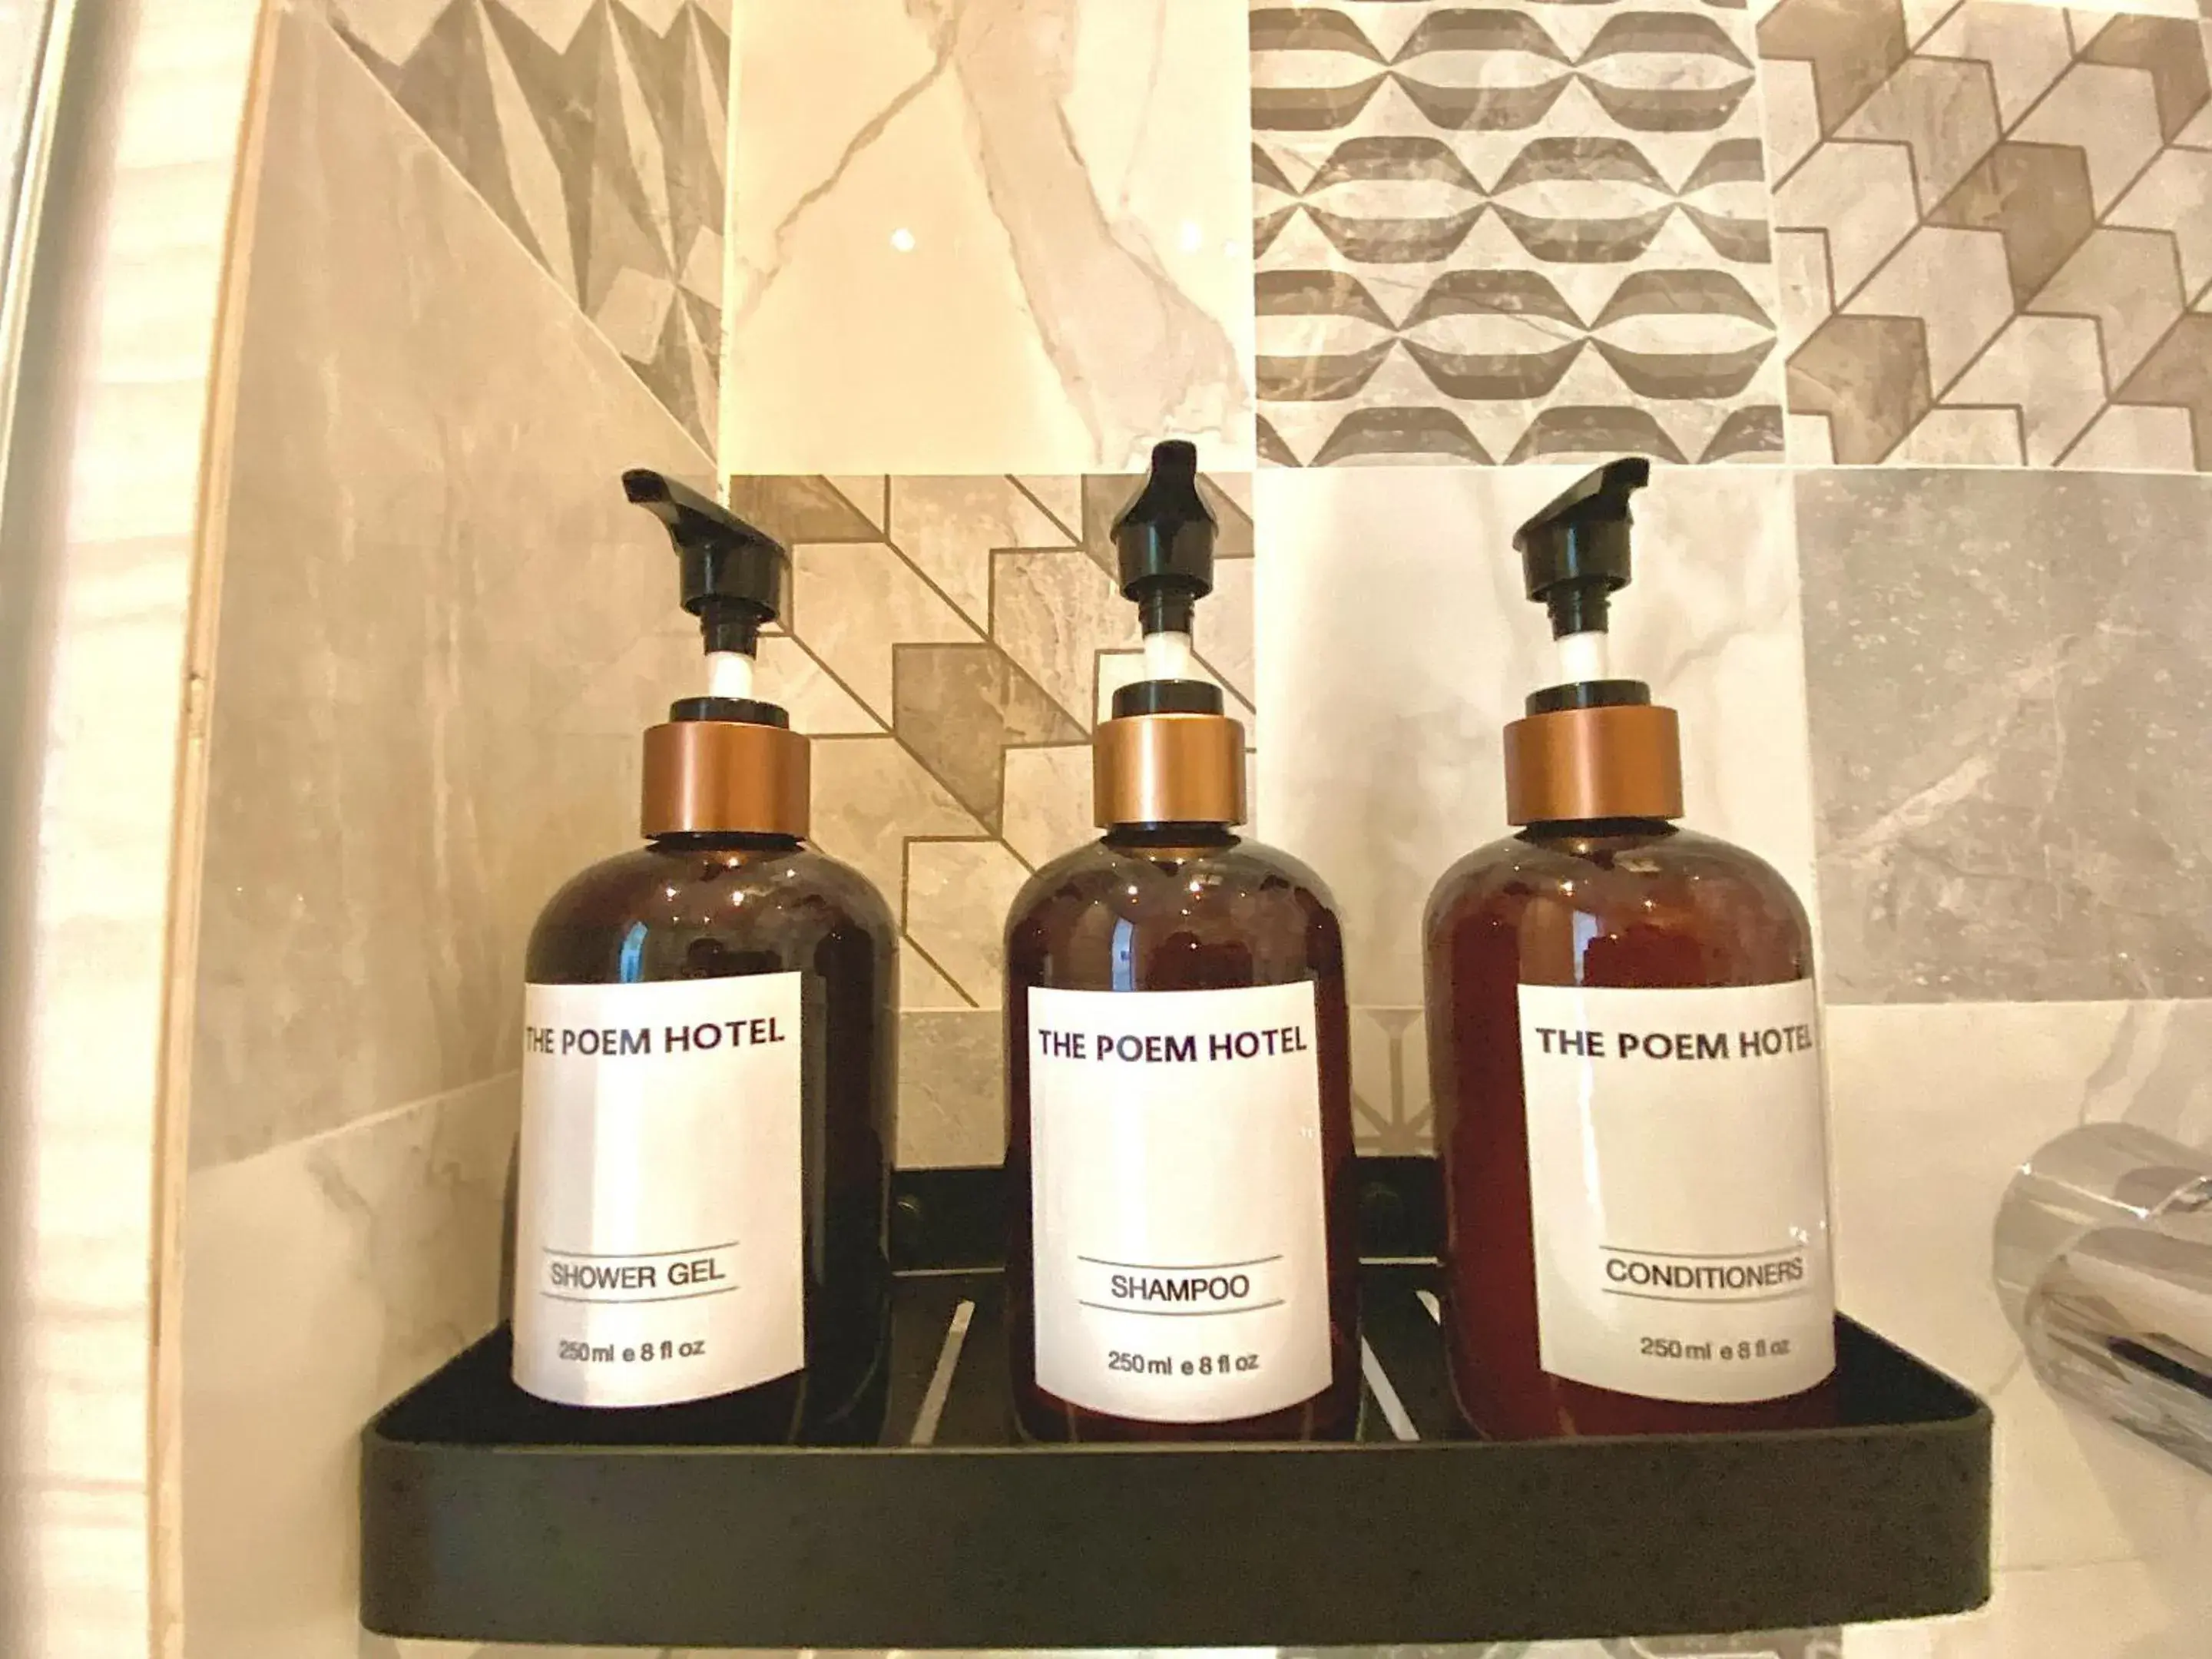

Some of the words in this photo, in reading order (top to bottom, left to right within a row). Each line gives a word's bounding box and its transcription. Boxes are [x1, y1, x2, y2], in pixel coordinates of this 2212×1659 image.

[527, 1026, 554, 1054] THE
[562, 1028, 651, 1055] POEM
[665, 1017, 785, 1053] HOTEL
[1038, 1029, 1086, 1060] THE
[1097, 1035, 1196, 1062] POEM
[1209, 1026, 1306, 1061] HOTEL
[1535, 1028, 1604, 1058] THE
[1618, 1032, 1729, 1060] POEM
[1739, 1024, 1812, 1057] HOTEL
[551, 1263, 655, 1290] SHOWER
[667, 1259, 726, 1286] GEL
[1111, 1274, 1250, 1301] SHAMPOO
[1606, 1257, 1803, 1290] CONDITIONERS
[641, 1345, 654, 1360] 8
[679, 1339, 706, 1356] oz
[1199, 1357, 1211, 1374] 8
[1236, 1354, 1259, 1370] oz
[1738, 1342, 1750, 1359] 8
